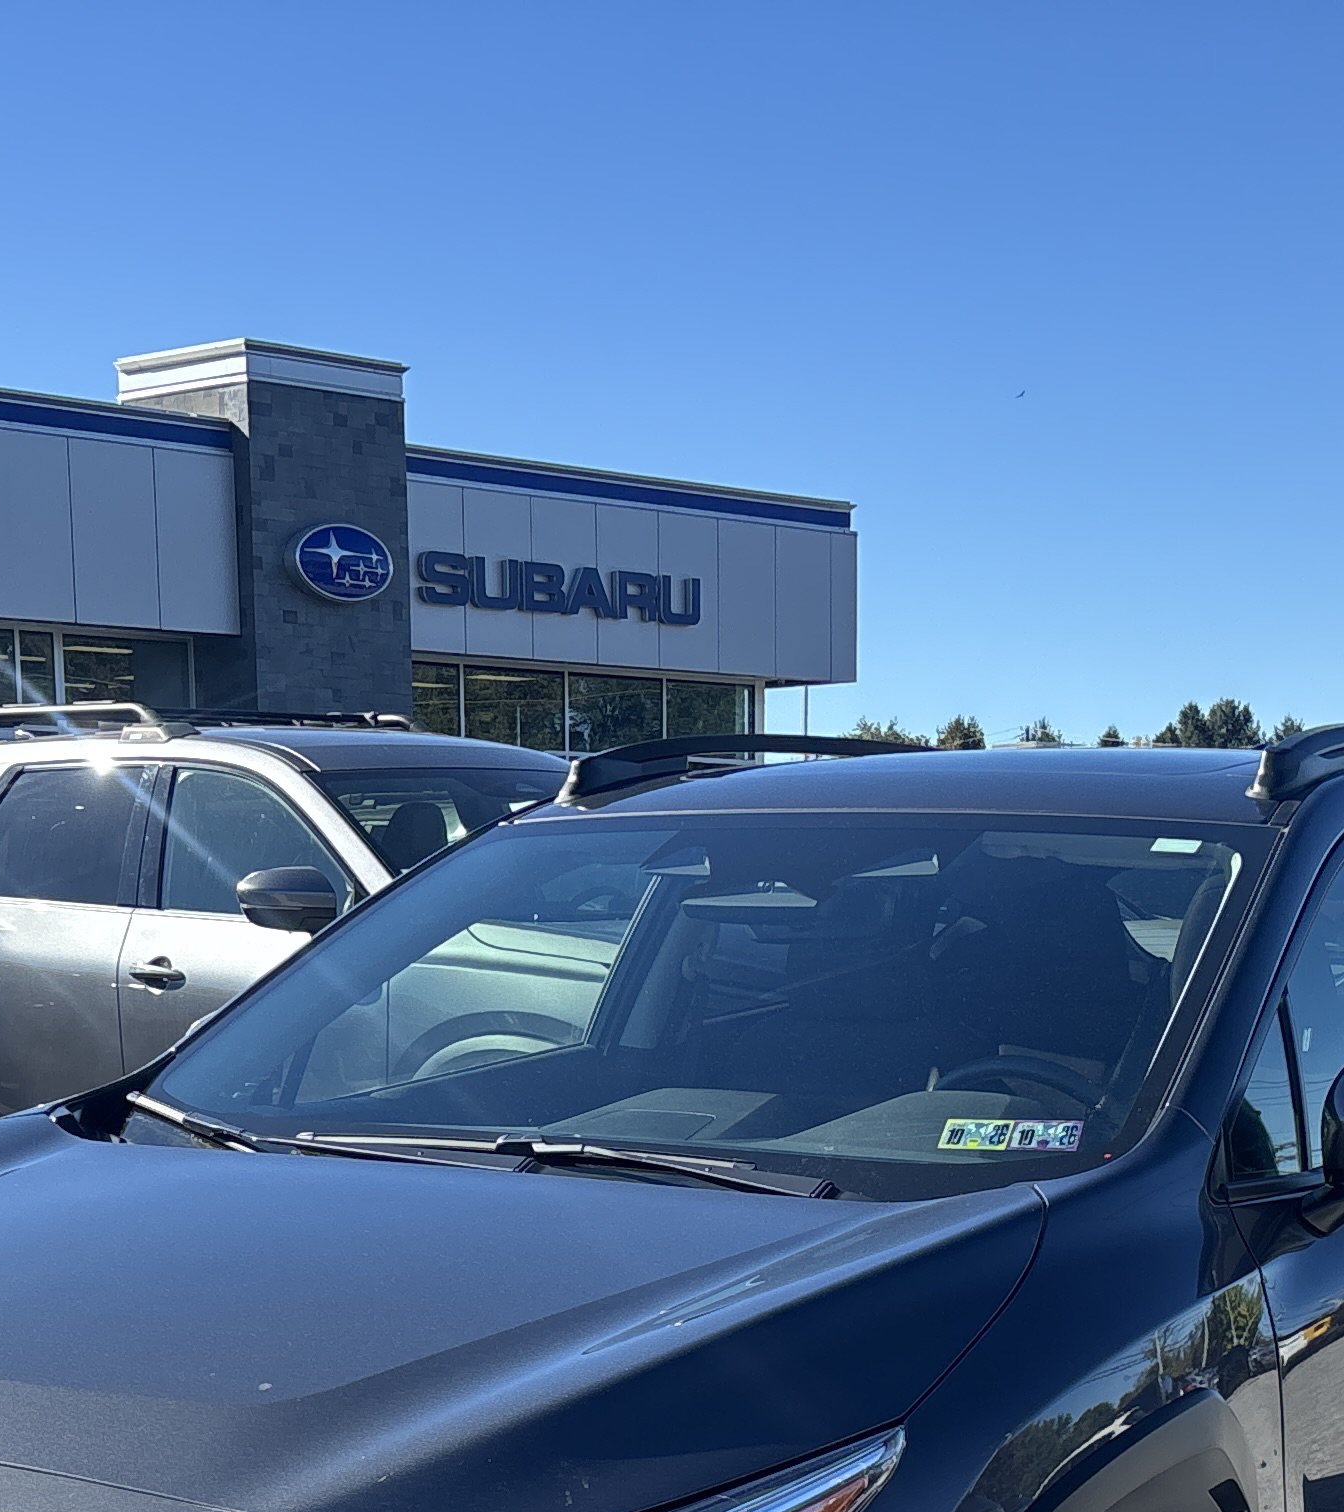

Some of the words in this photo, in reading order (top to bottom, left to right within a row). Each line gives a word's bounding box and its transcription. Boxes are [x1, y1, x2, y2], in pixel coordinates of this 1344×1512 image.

[416, 550, 702, 626] SUBARU
[946, 1127, 966, 1145] 10
[988, 1124, 1008, 1145] 26
[1017, 1127, 1036, 1146] 10
[1058, 1124, 1079, 1146] 26
